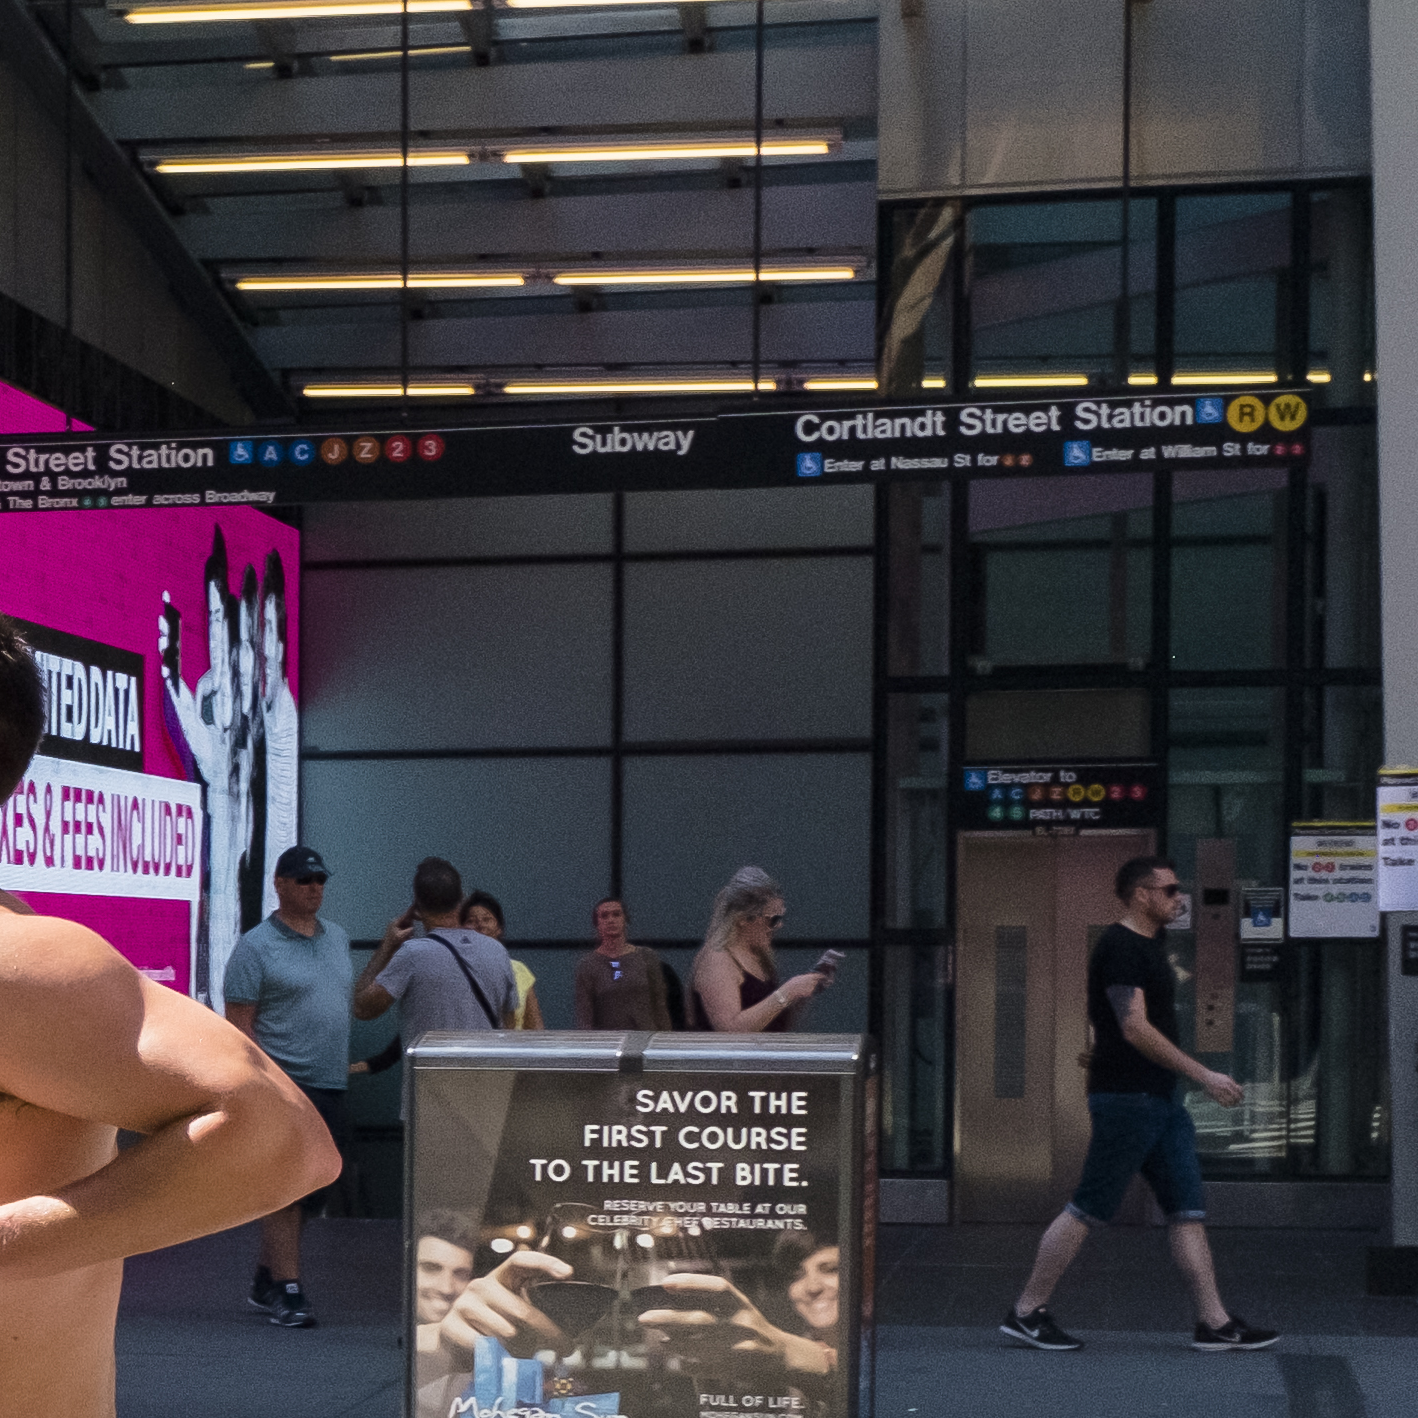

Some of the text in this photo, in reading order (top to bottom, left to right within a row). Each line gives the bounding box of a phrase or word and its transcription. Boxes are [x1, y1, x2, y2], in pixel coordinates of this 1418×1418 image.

[795, 410, 946, 442] Cortlandt
[959, 405, 1062, 436] Street
[1074, 400, 1193, 430] Station
[572, 427, 695, 455] Subway
[1091, 448, 1134, 462] Enter
[1139, 447, 1156, 460] at
[1222, 443, 1241, 456] St
[1247, 442, 1270, 455] for
[5, 447, 96, 473] Street
[108, 442, 214, 470] Station
[823, 459, 865, 472] Enter
[870, 458, 886, 471] at
[891, 457, 948, 469] Nassau
[953, 454, 971, 467] St
[977, 453, 999, 466] for
[40, 477, 51, 490] &
[58, 475, 127, 491] Brooklyn
[7, 496, 32, 509] The
[38, 495, 78, 508] Bronx
[110, 493, 147, 506] enter
[152, 492, 200, 504] across
[205, 489, 276, 504] Broadway
[89, 666, 141, 753] DATA
[987, 770, 1077, 784] Elevator to
[43, 782, 55, 869] &
[61, 785, 106, 872] FEES
[111, 793, 194, 878] INCLUDED
[636, 1089, 808, 1115] SAVOR THE
[584, 1125, 808, 1151] FIRST COURSE
[529, 1159, 809, 1187] TO THE LAST BITE.
[603, 1200, 807, 1215] RESERVE YOUR TABLE AT OUR
[699, 1394, 739, 1406] FULL
[741, 1395, 764, 1407] OF
